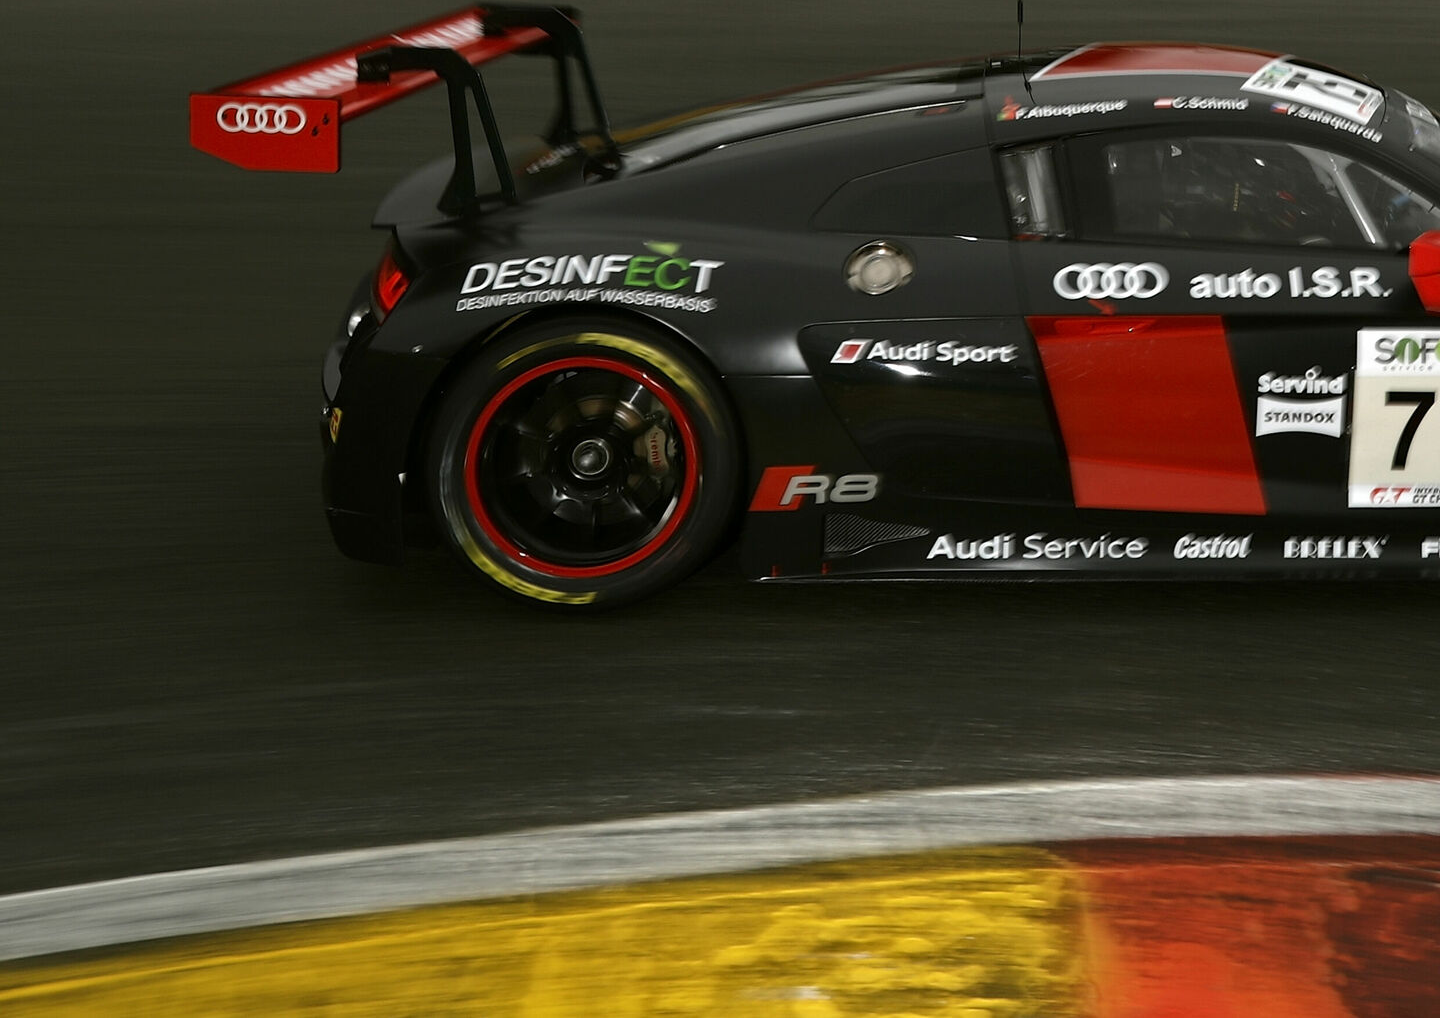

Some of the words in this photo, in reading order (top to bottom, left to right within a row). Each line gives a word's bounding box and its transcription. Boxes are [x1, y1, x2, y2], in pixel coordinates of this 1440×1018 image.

[1172, 96, 1249, 111] C.Schmid
[460, 254, 725, 294] DESINFECT
[1189, 267, 1283, 298] auto
[1288, 266, 1393, 298] I.S.R.
[455, 289, 562, 312] DESINFEKTION
[563, 289, 601, 302] AUF
[600, 288, 718, 313] WASSERBASIS
[866, 340, 934, 361] Audi
[935, 340, 1018, 366] Sport
[1258, 365, 1347, 395] Servind
[1383, 364, 1433, 372] service
[1264, 411, 1335, 424] STANDOX
[779, 474, 879, 506] R8
[1413, 494, 1429, 504] GT
[926, 533, 1016, 560] Audi
[1022, 532, 1150, 560] Service
[1173, 533, 1253, 560] Castrol
[1283, 535, 1386, 559] BRELEX
